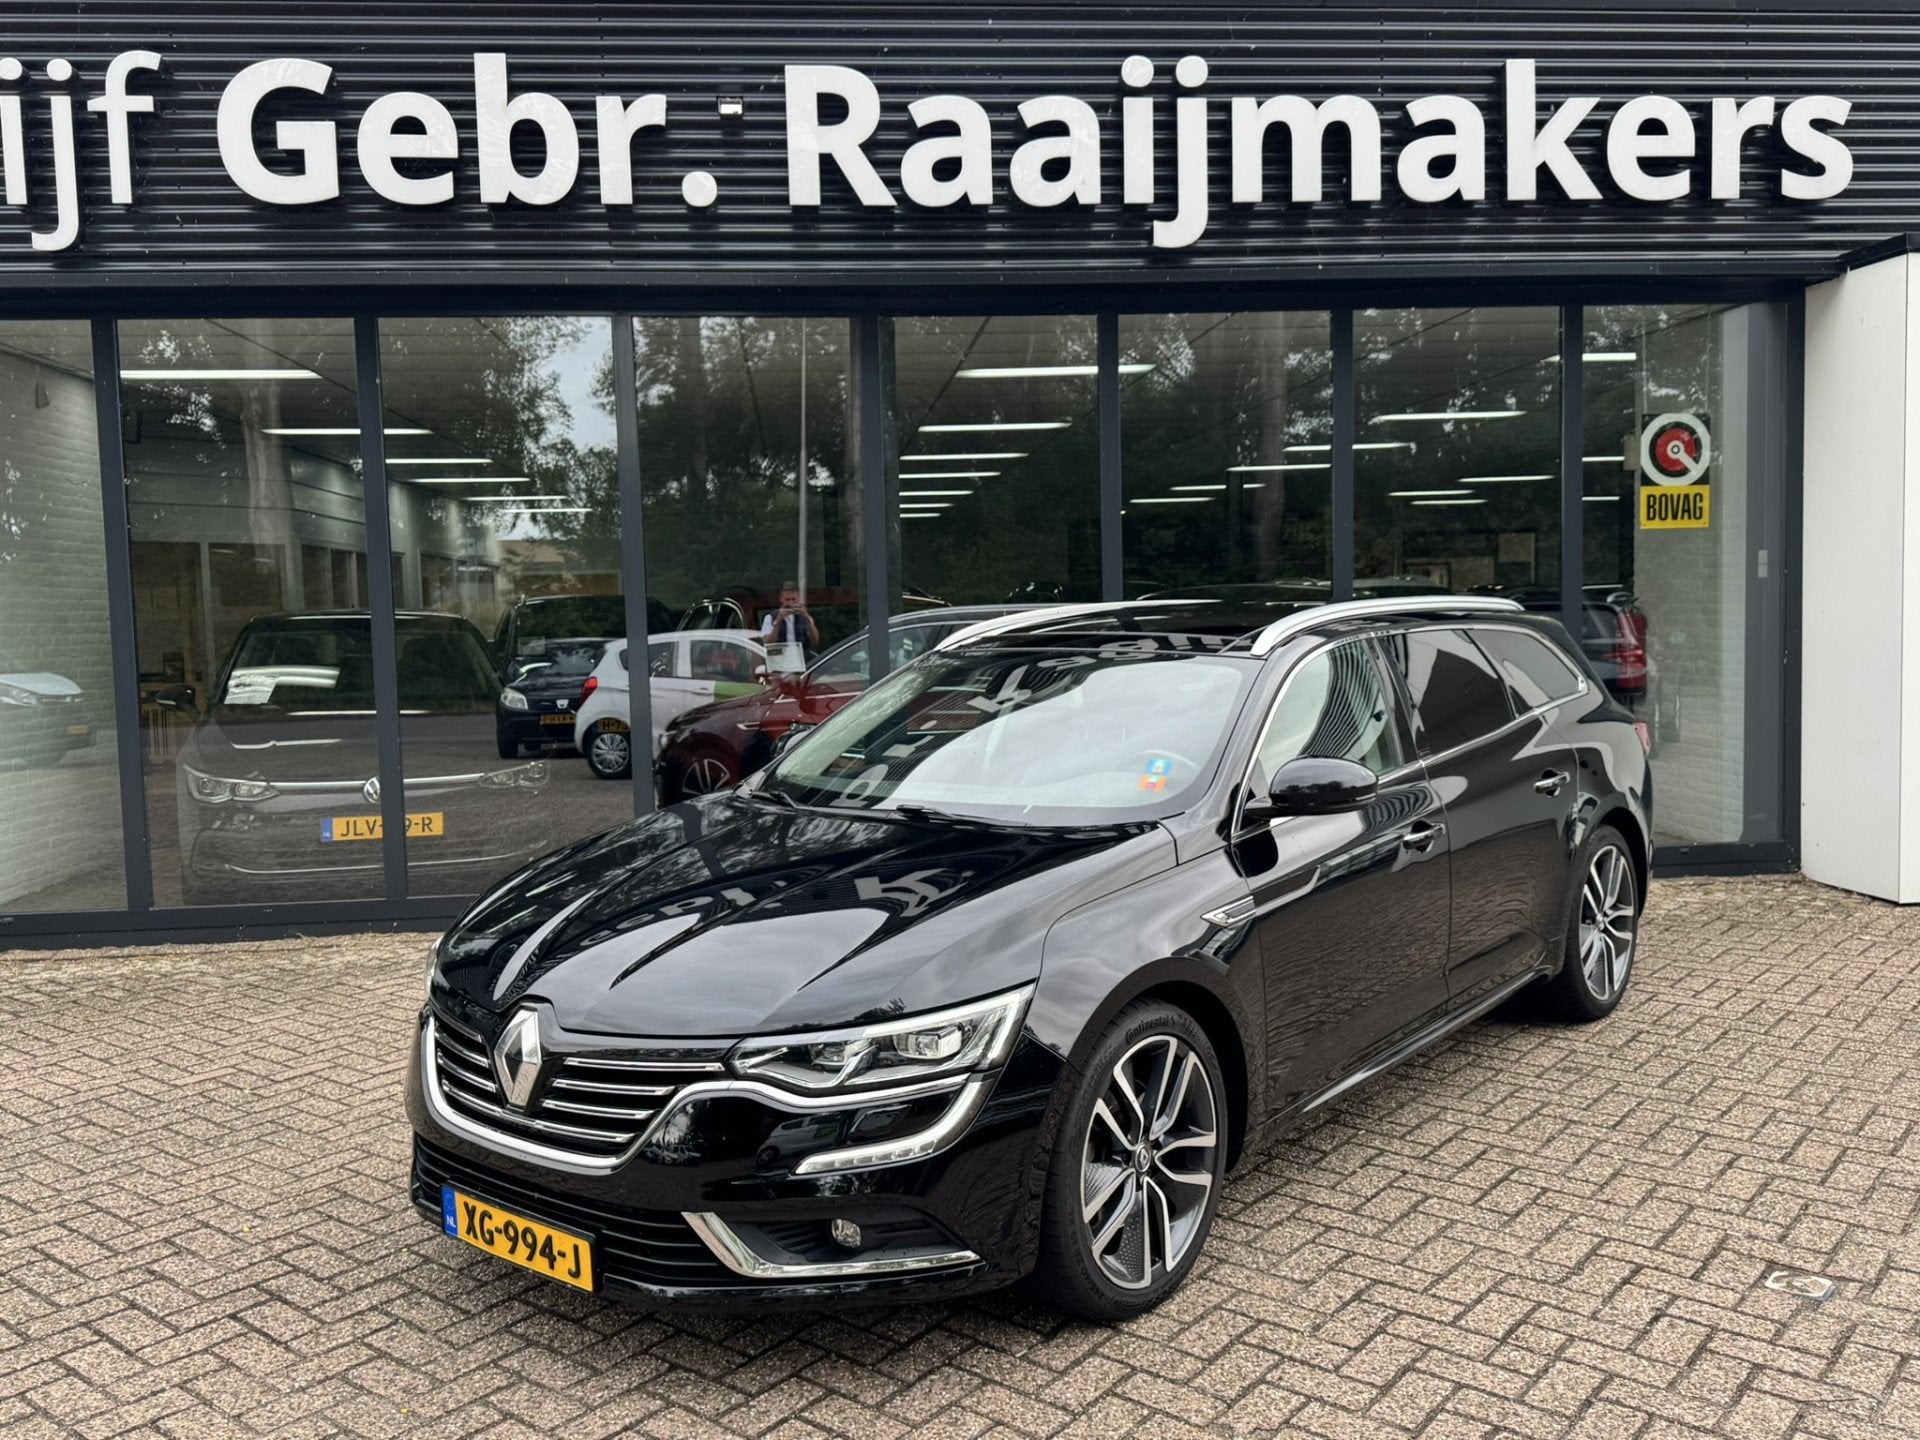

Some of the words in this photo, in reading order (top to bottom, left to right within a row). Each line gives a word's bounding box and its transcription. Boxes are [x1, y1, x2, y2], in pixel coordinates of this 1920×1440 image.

[0, 50, 162, 252] ijf
[216, 52, 718, 207] Gebr.
[784, 56, 1853, 248] Raaijmakers
[1646, 492, 1704, 522] BOVAG
[341, 816, 433, 837] JLV-9-R
[446, 1214, 457, 1228] NL
[463, 1201, 581, 1279] XG-994-J
